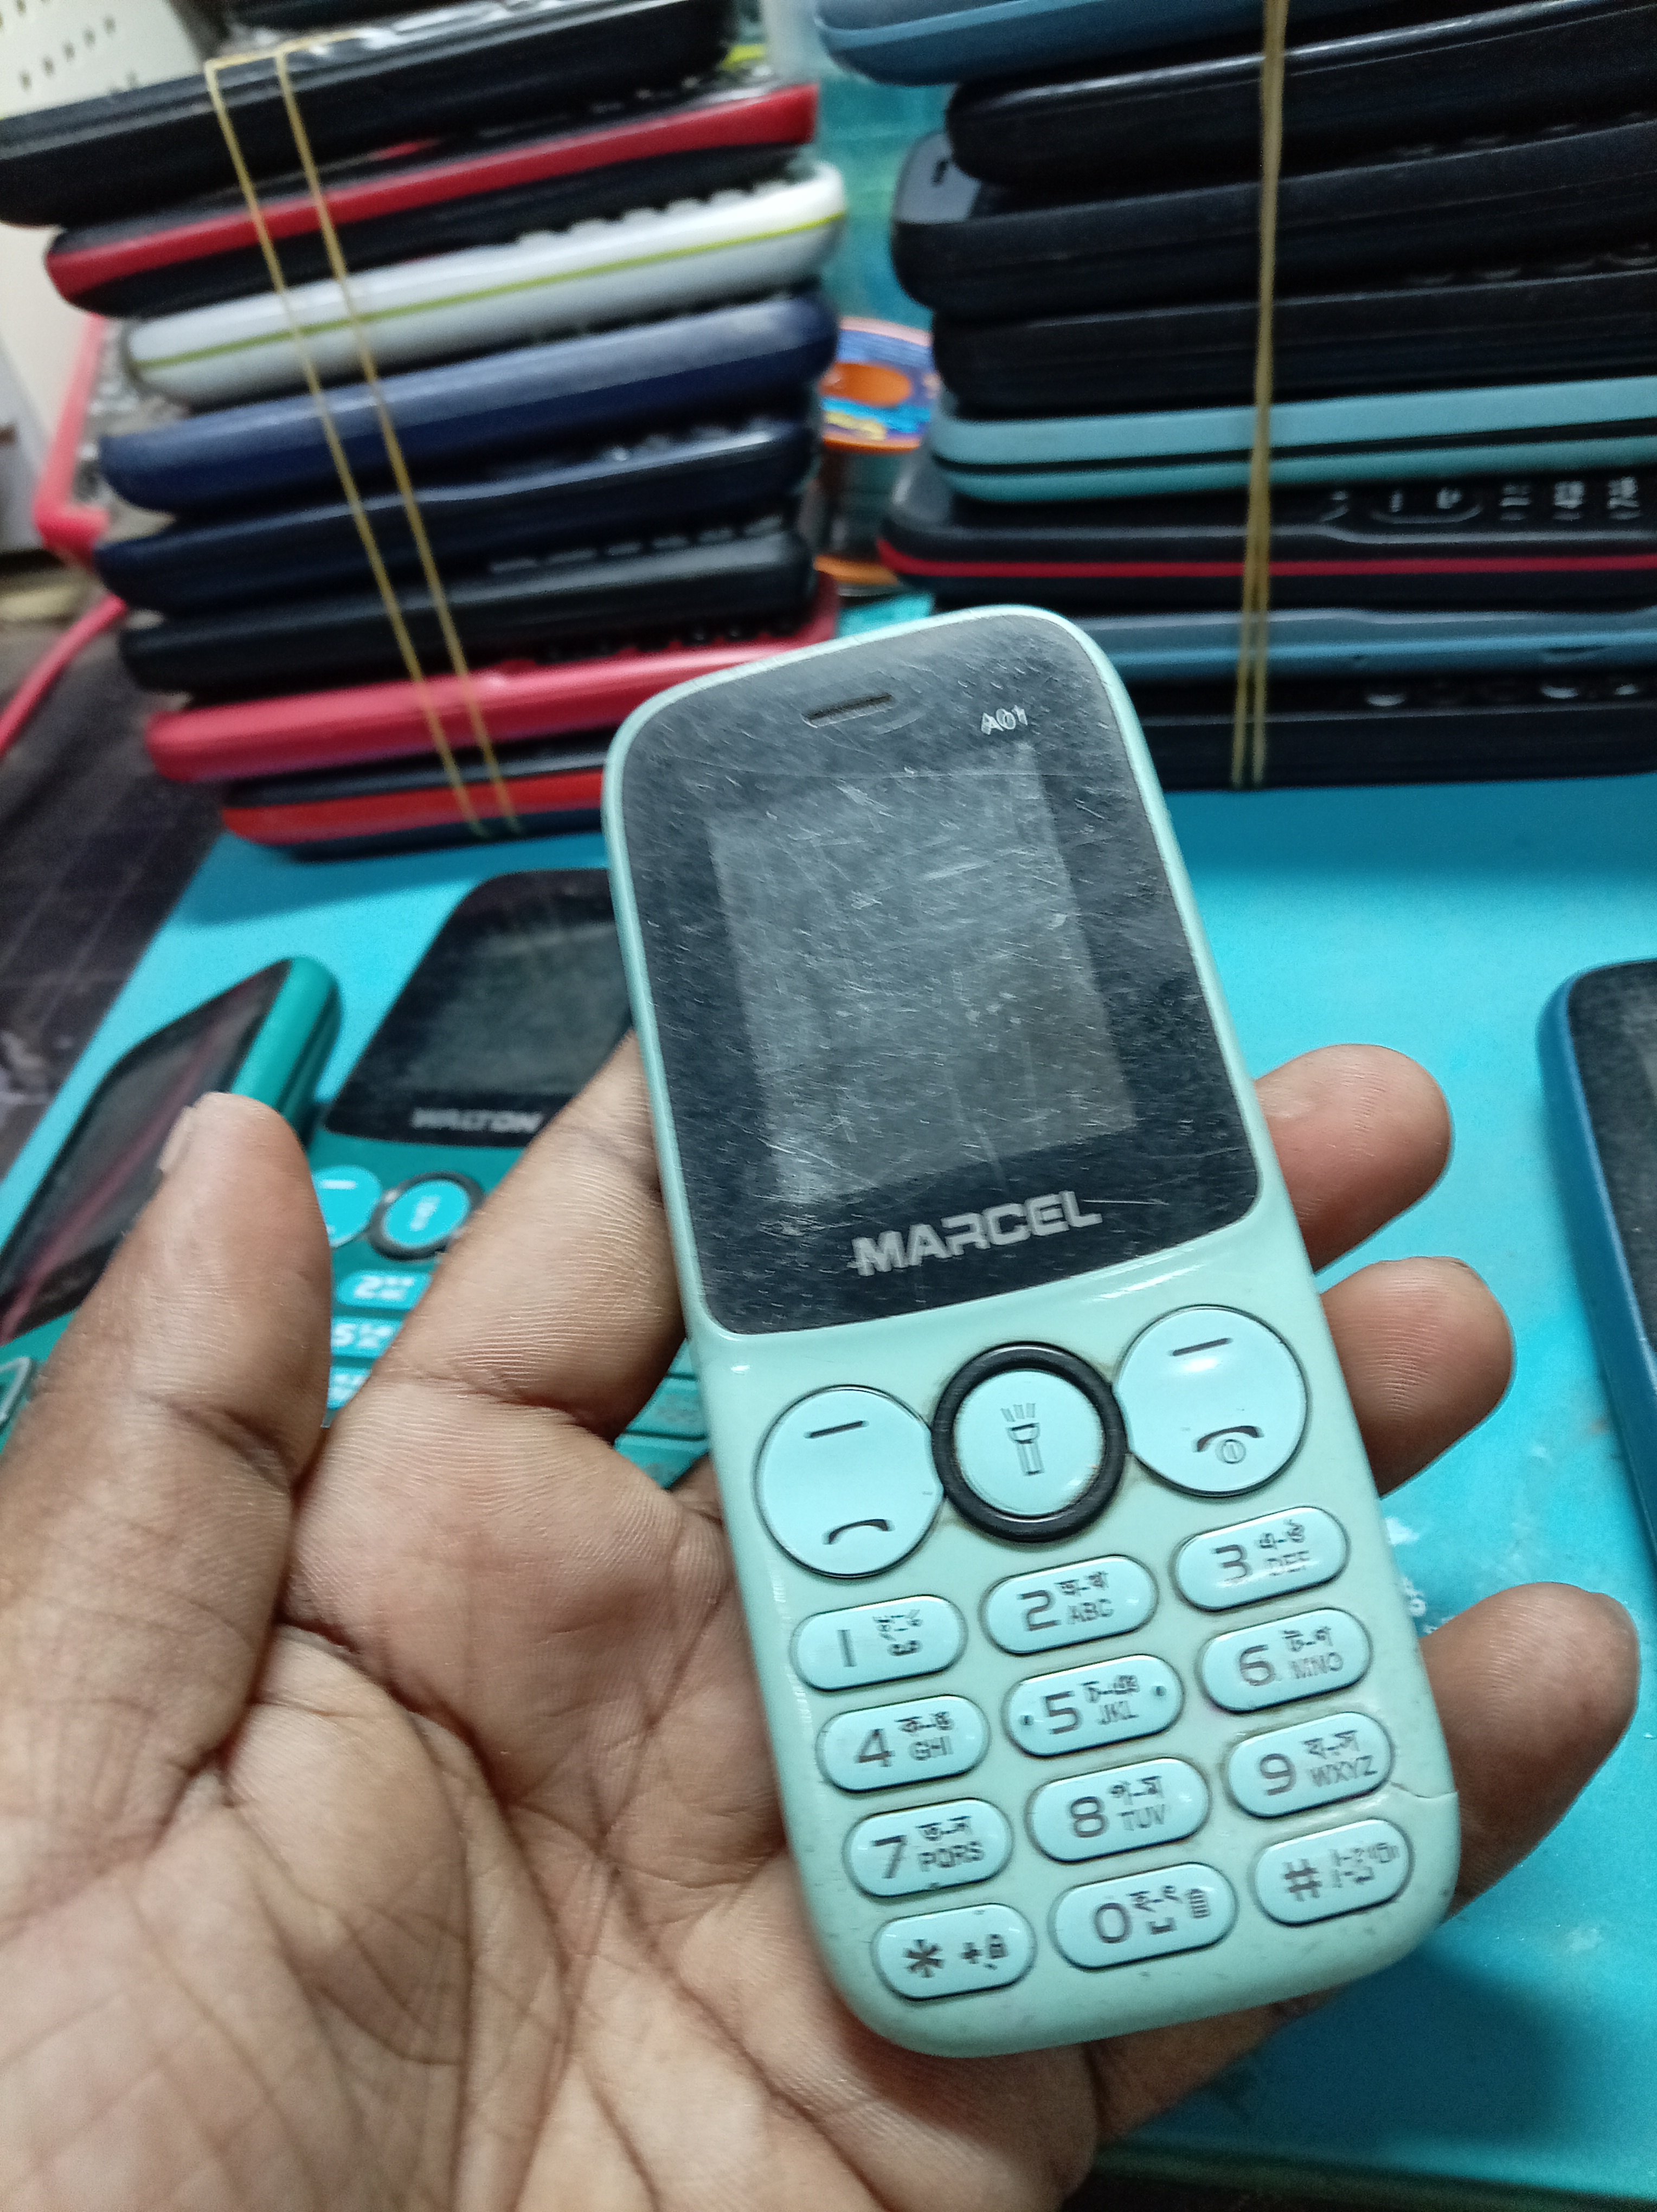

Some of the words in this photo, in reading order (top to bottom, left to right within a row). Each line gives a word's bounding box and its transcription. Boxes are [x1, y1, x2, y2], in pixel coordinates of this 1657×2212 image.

[981, 704, 1029, 736] A01
[851, 1190, 1103, 1277] MARCEL
[1211, 1544, 1251, 1584] 3
[1018, 1589, 1062, 1631] 2
[1065, 1598, 1115, 1625] ABC
[1237, 1644, 1275, 1687] 6
[1041, 1690, 1084, 1735] 5
[854, 1728, 896, 1768] 4
[1257, 1752, 1298, 1797] 9
[1308, 1754, 1378, 1787] WXYZ
[1068, 1796, 1110, 1839] 8
[1119, 1803, 1166, 1831] TUV
[870, 1834, 908, 1879] 7
[917, 1840, 985, 1873] PQRS
[1281, 1858, 1324, 1902] #
[1093, 1901, 1134, 1944] 0
